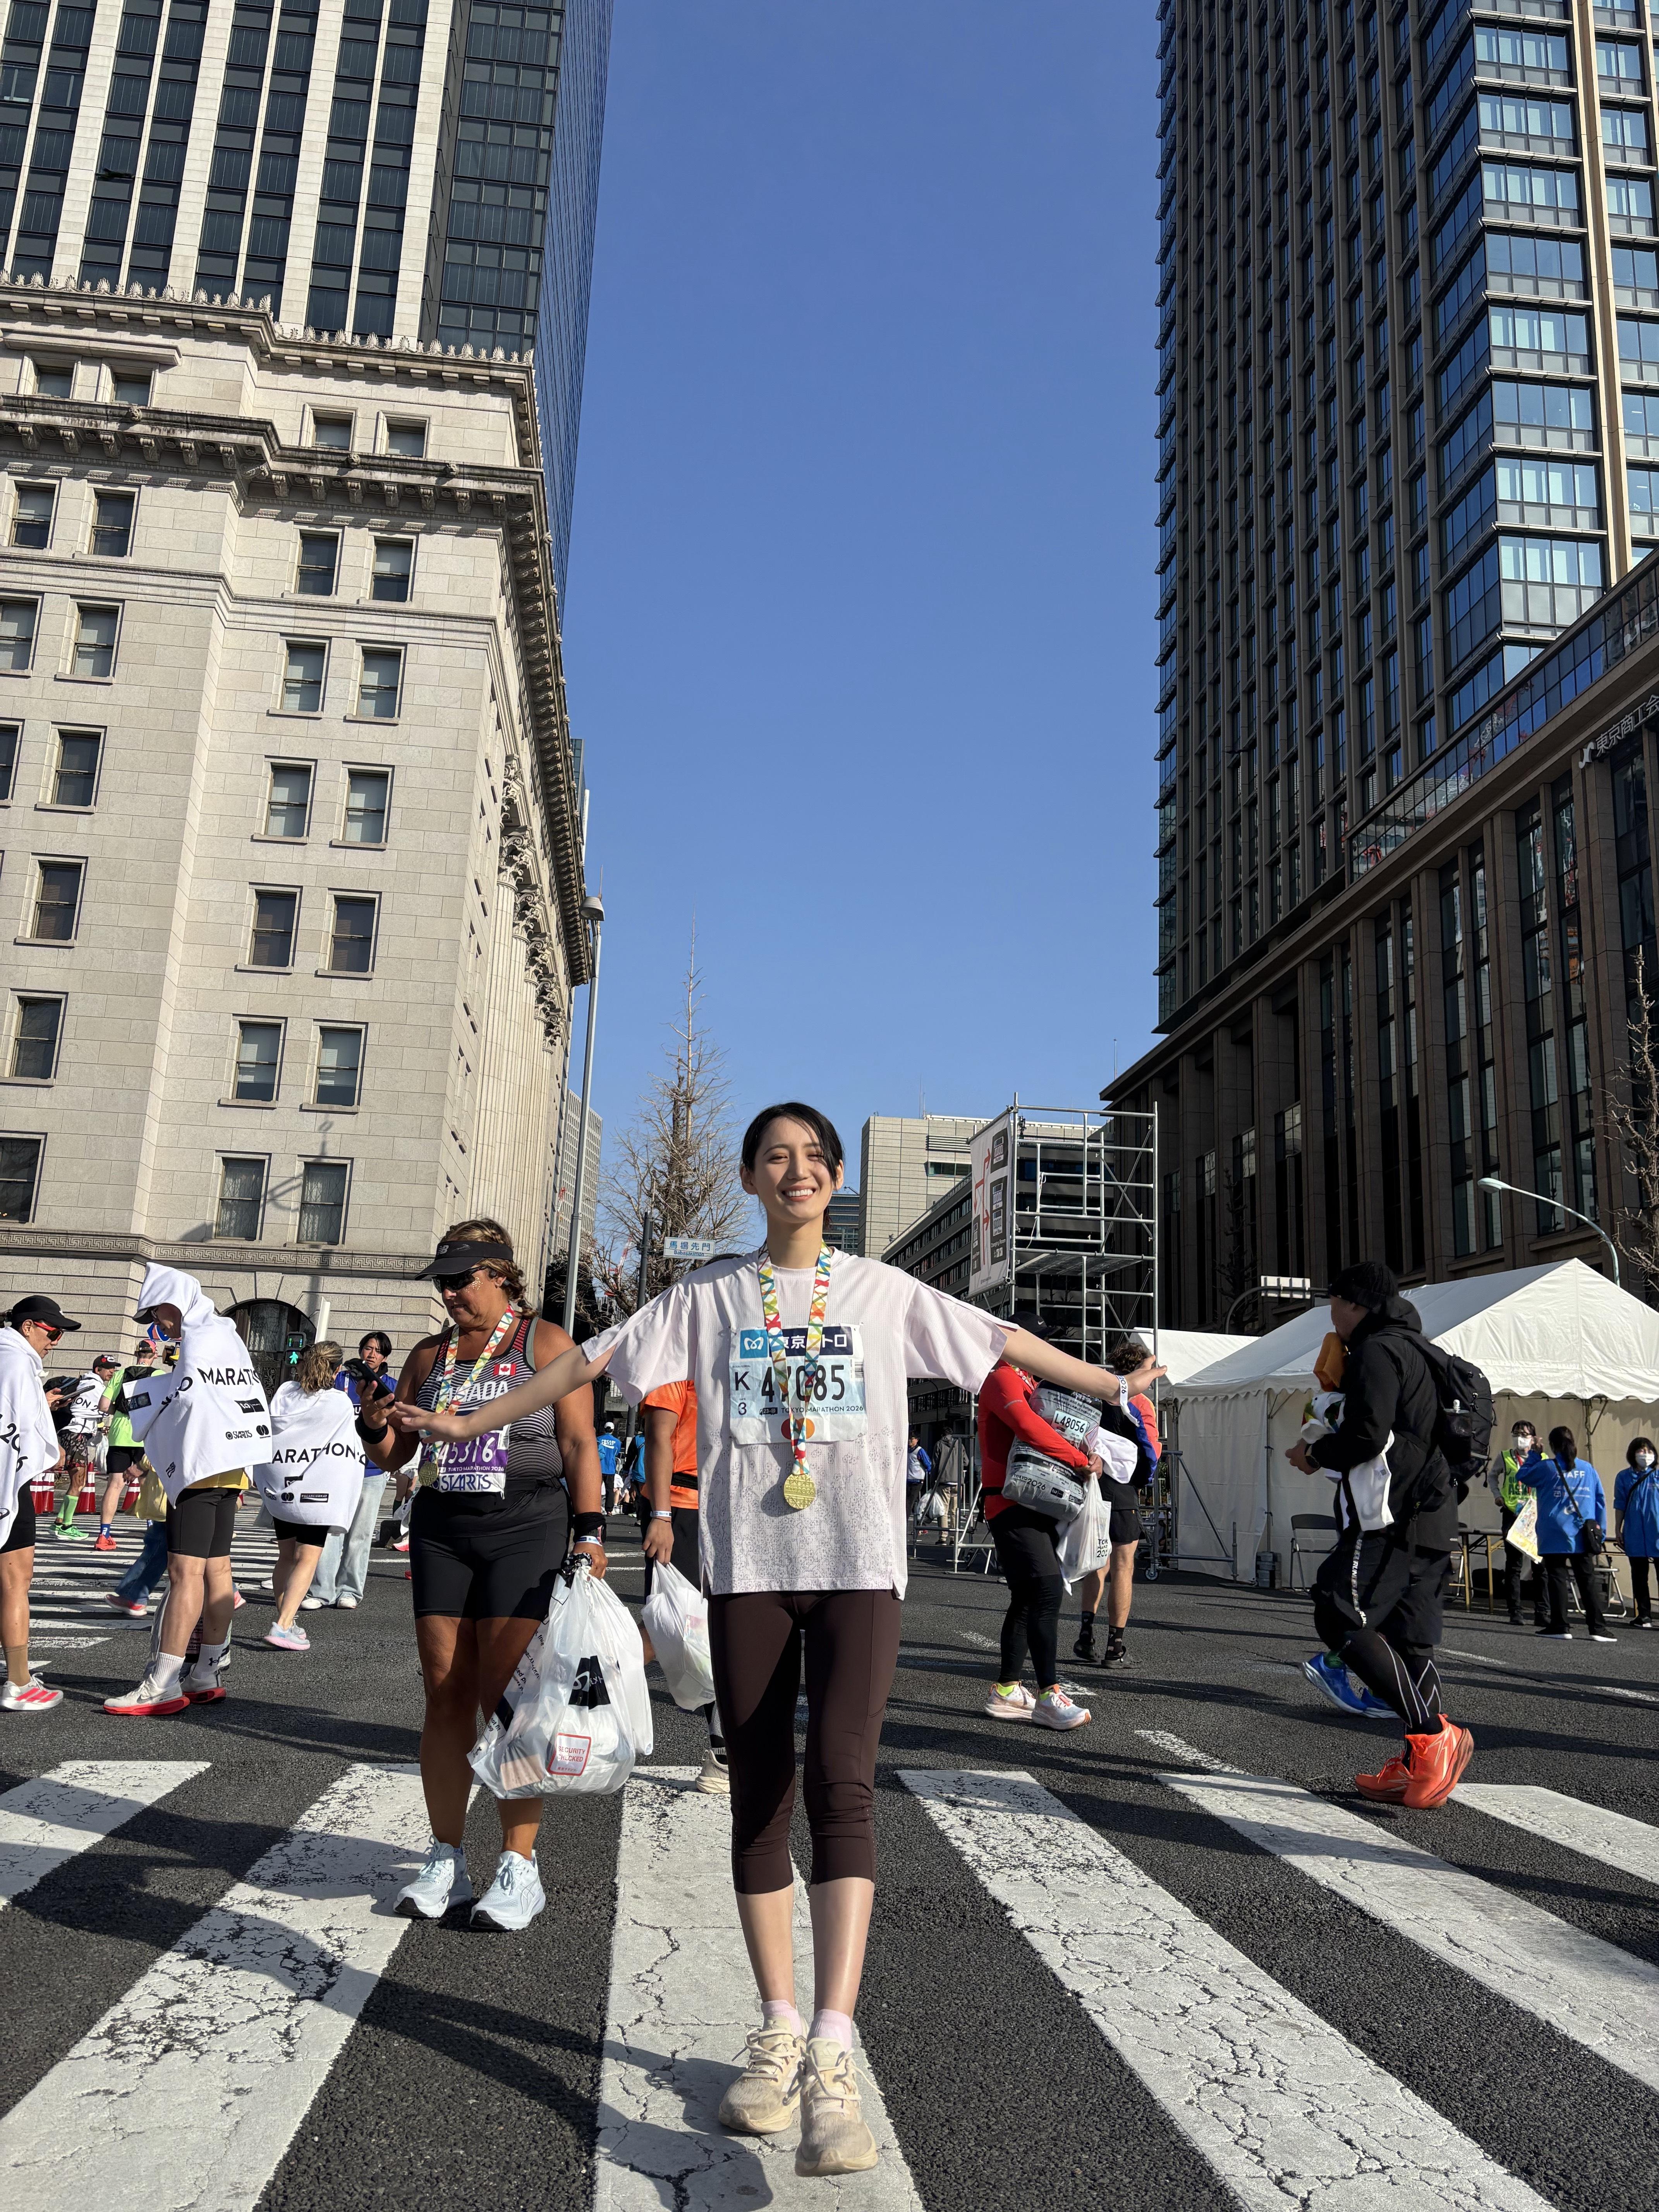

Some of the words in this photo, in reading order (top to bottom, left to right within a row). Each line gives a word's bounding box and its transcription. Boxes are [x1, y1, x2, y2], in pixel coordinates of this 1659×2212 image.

[670, 1241, 710, 1251] 馬場先門
[735, 1371, 750, 1391] K
[761, 1365, 845, 1403] 4085
[738, 1402, 747, 1415] 3
[1054, 1413, 1085, 1433] L48056
[271, 1442, 356, 1464] ARATHON
[798, 1487, 814, 1495] 2026
[1027, 1479, 1046, 1490] 2026
[558, 1746, 585, 1755] SECURITY
